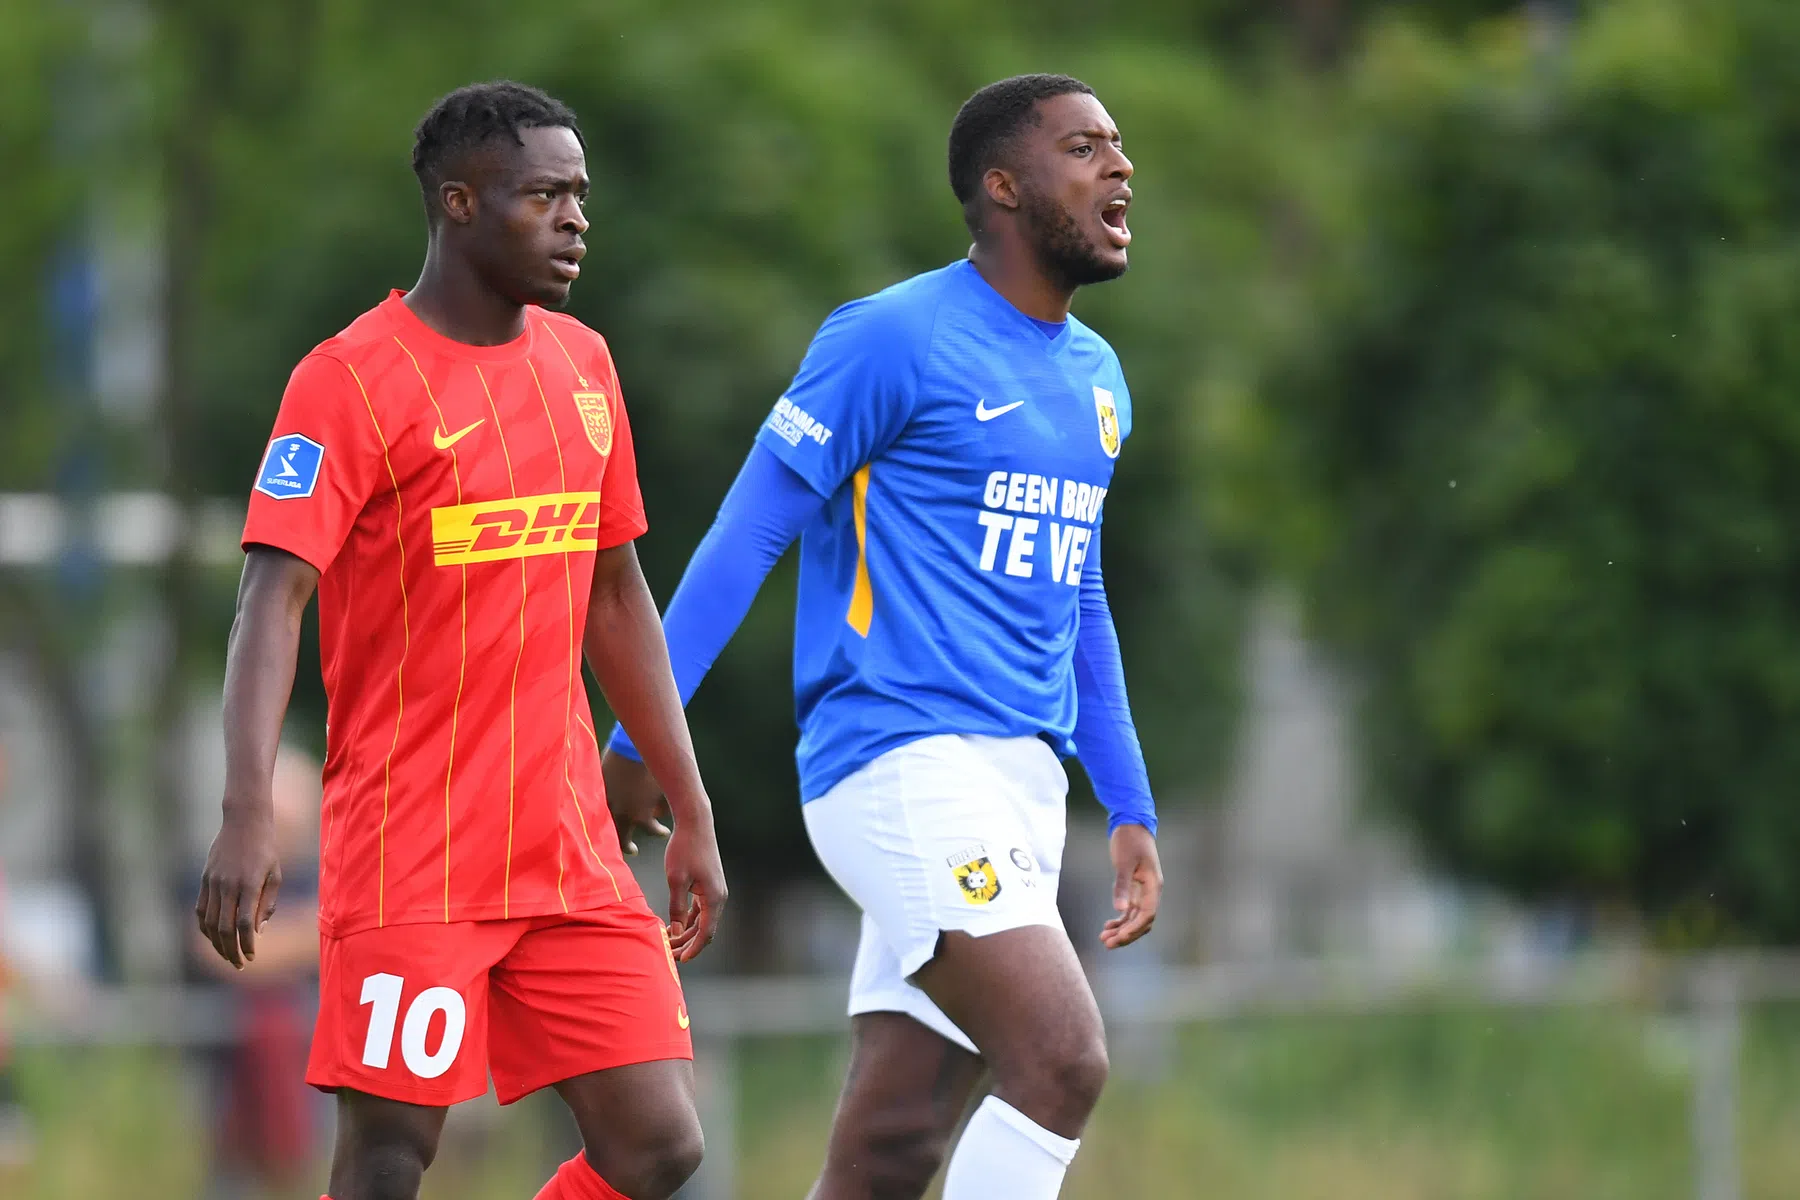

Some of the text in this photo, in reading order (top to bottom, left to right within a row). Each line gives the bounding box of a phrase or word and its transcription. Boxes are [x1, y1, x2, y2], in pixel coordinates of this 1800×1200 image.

[470, 502, 600, 553] DHL
[983, 470, 1108, 524] GEEN BRU
[978, 510, 1092, 586] TE VE
[359, 972, 466, 1079] 10
